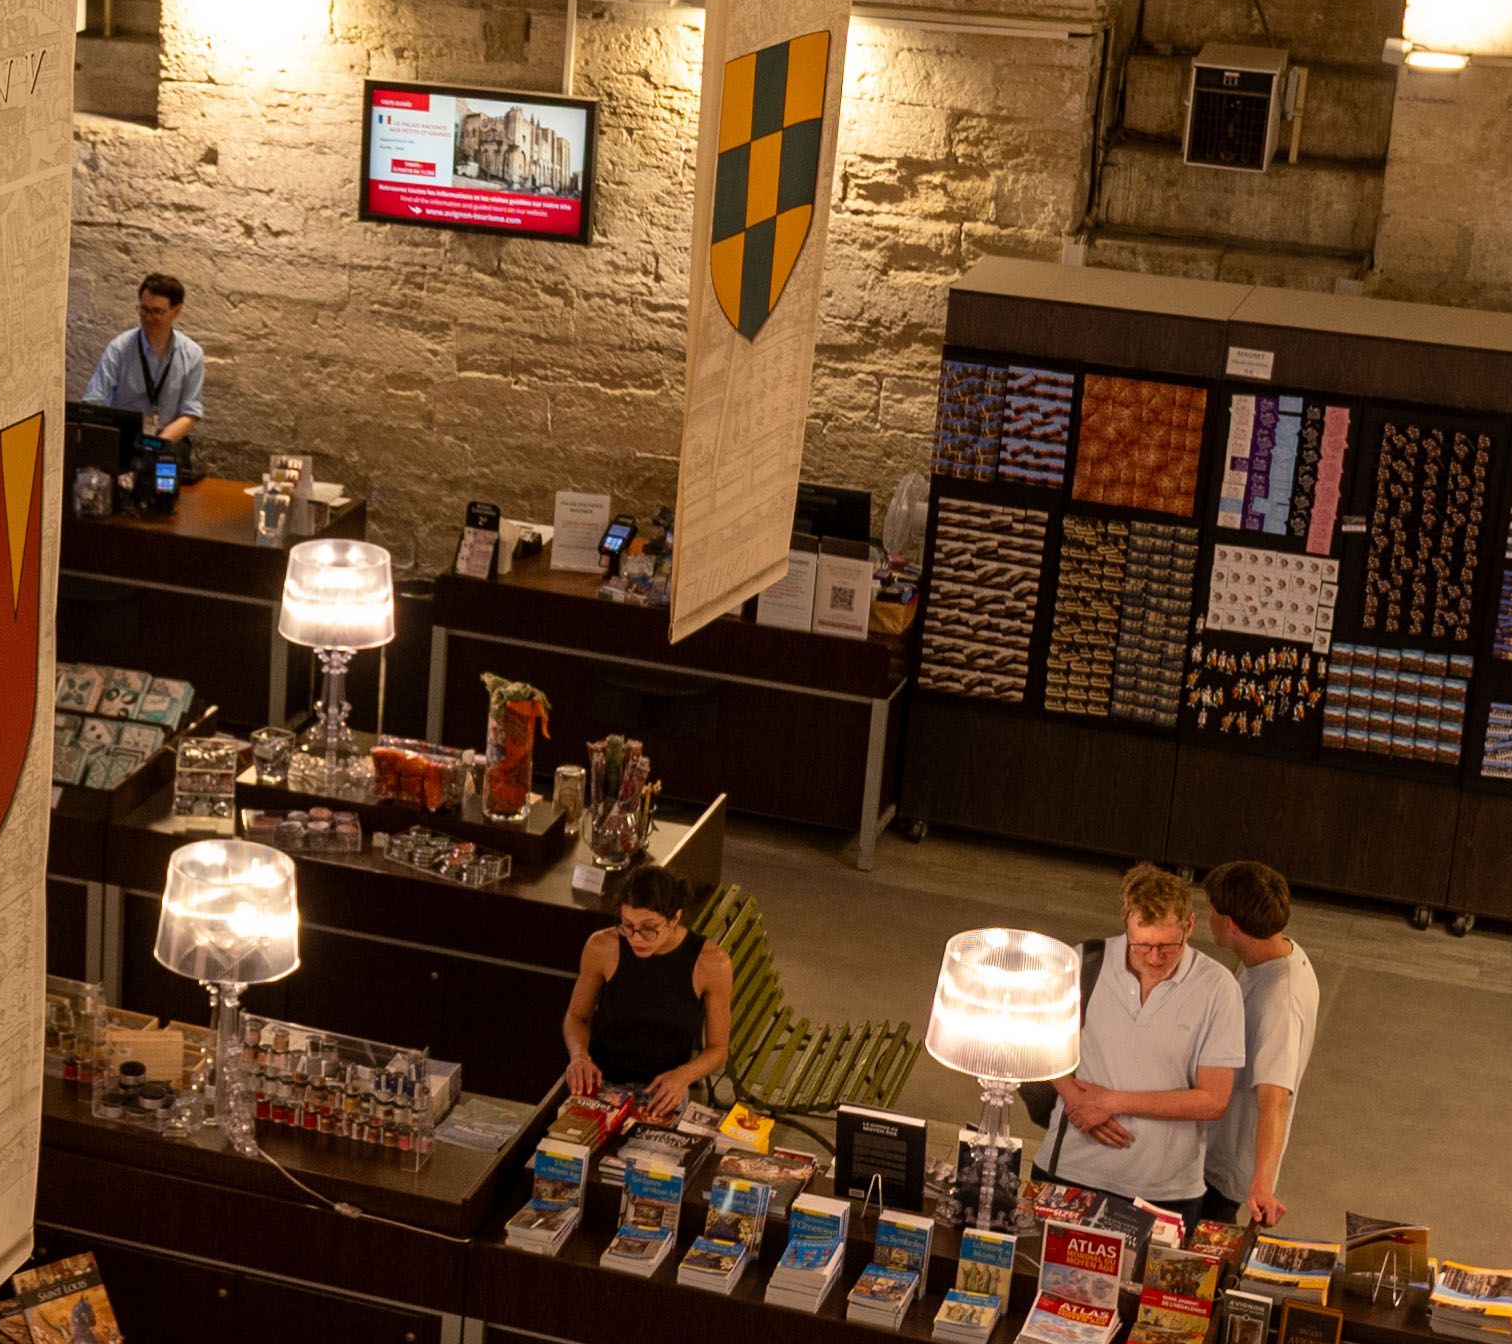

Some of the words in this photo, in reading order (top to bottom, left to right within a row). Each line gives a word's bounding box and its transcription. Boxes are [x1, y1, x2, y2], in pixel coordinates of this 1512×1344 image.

[25, 49, 48, 95] V
[1067, 1237, 1118, 1259] ATLAS
[1065, 1257, 1095, 1271] MOYEN
[1059, 1302, 1110, 1320] ATLAS
